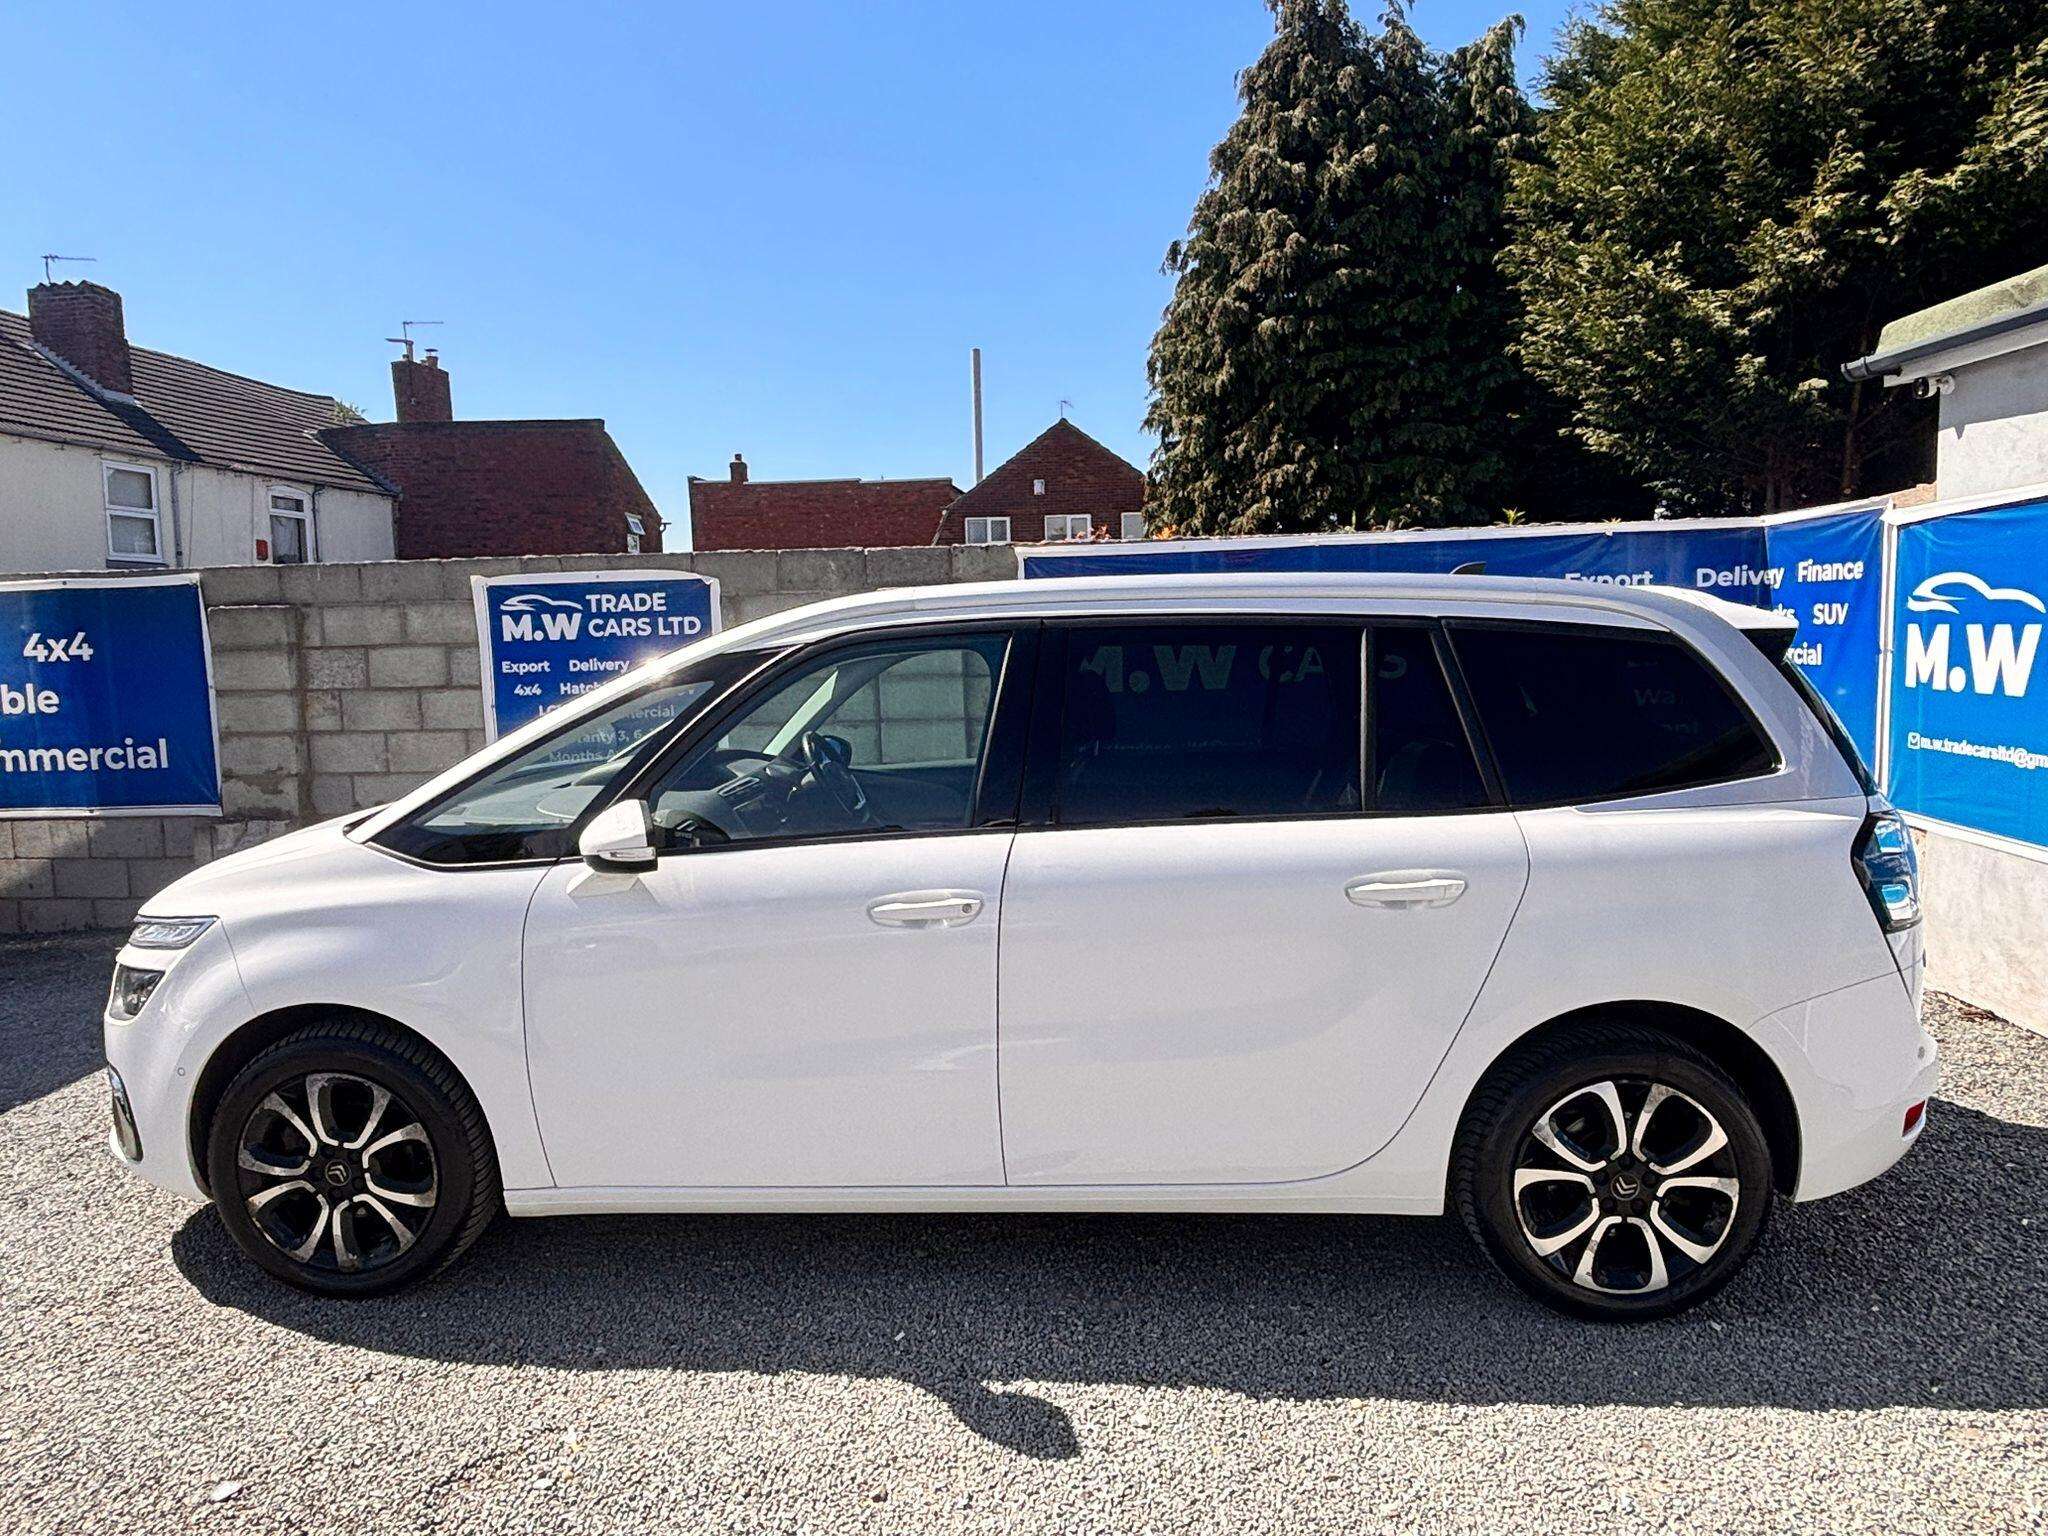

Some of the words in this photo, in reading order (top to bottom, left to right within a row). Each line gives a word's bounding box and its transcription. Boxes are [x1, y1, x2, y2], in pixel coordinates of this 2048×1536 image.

[1696, 564, 1785, 589] Delivery
[1797, 558, 1864, 583] Finance
[585, 592, 667, 613] TRADE
[1812, 602, 1849, 625] SUV
[501, 613, 582, 642] M.W
[588, 617, 652, 637] CARS
[658, 616, 702, 636] LTD
[23, 631, 94, 662] 4x4
[502, 660, 551, 675] Export
[569, 657, 630, 673] Delivery
[1905, 623, 2043, 698] M.W
[0, 683, 60, 715] ble
[514, 683, 542, 696] 4x4
